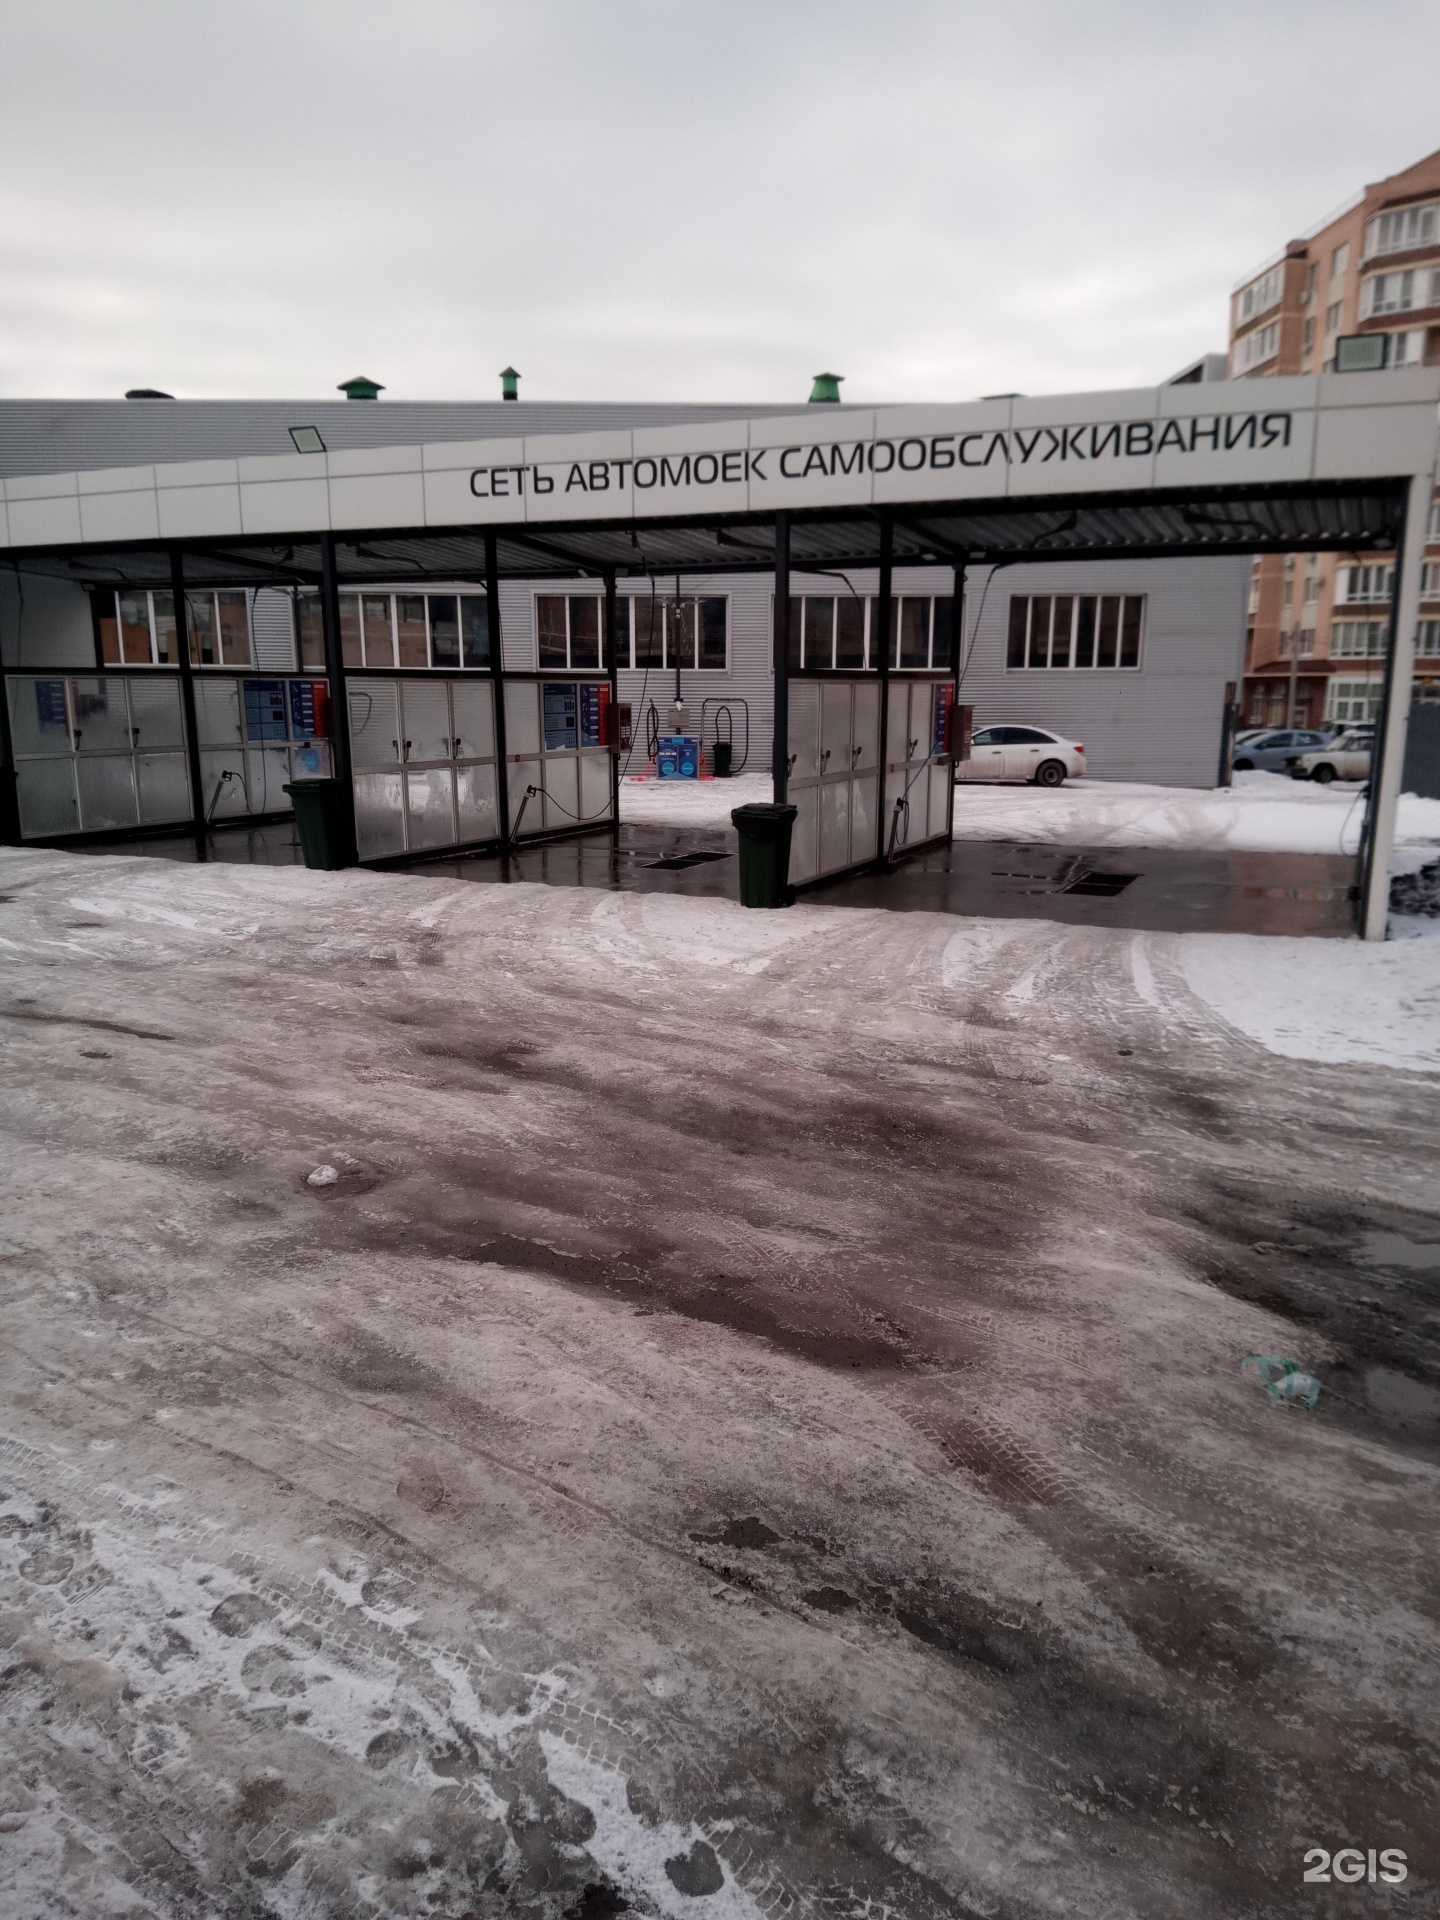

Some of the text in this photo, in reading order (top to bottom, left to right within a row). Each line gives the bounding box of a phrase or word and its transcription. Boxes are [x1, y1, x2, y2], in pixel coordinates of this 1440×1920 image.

[470, 412, 1293, 498] СЕТЬ АВТОМОЕК САМООБСЛУЖИВАНИЯ
